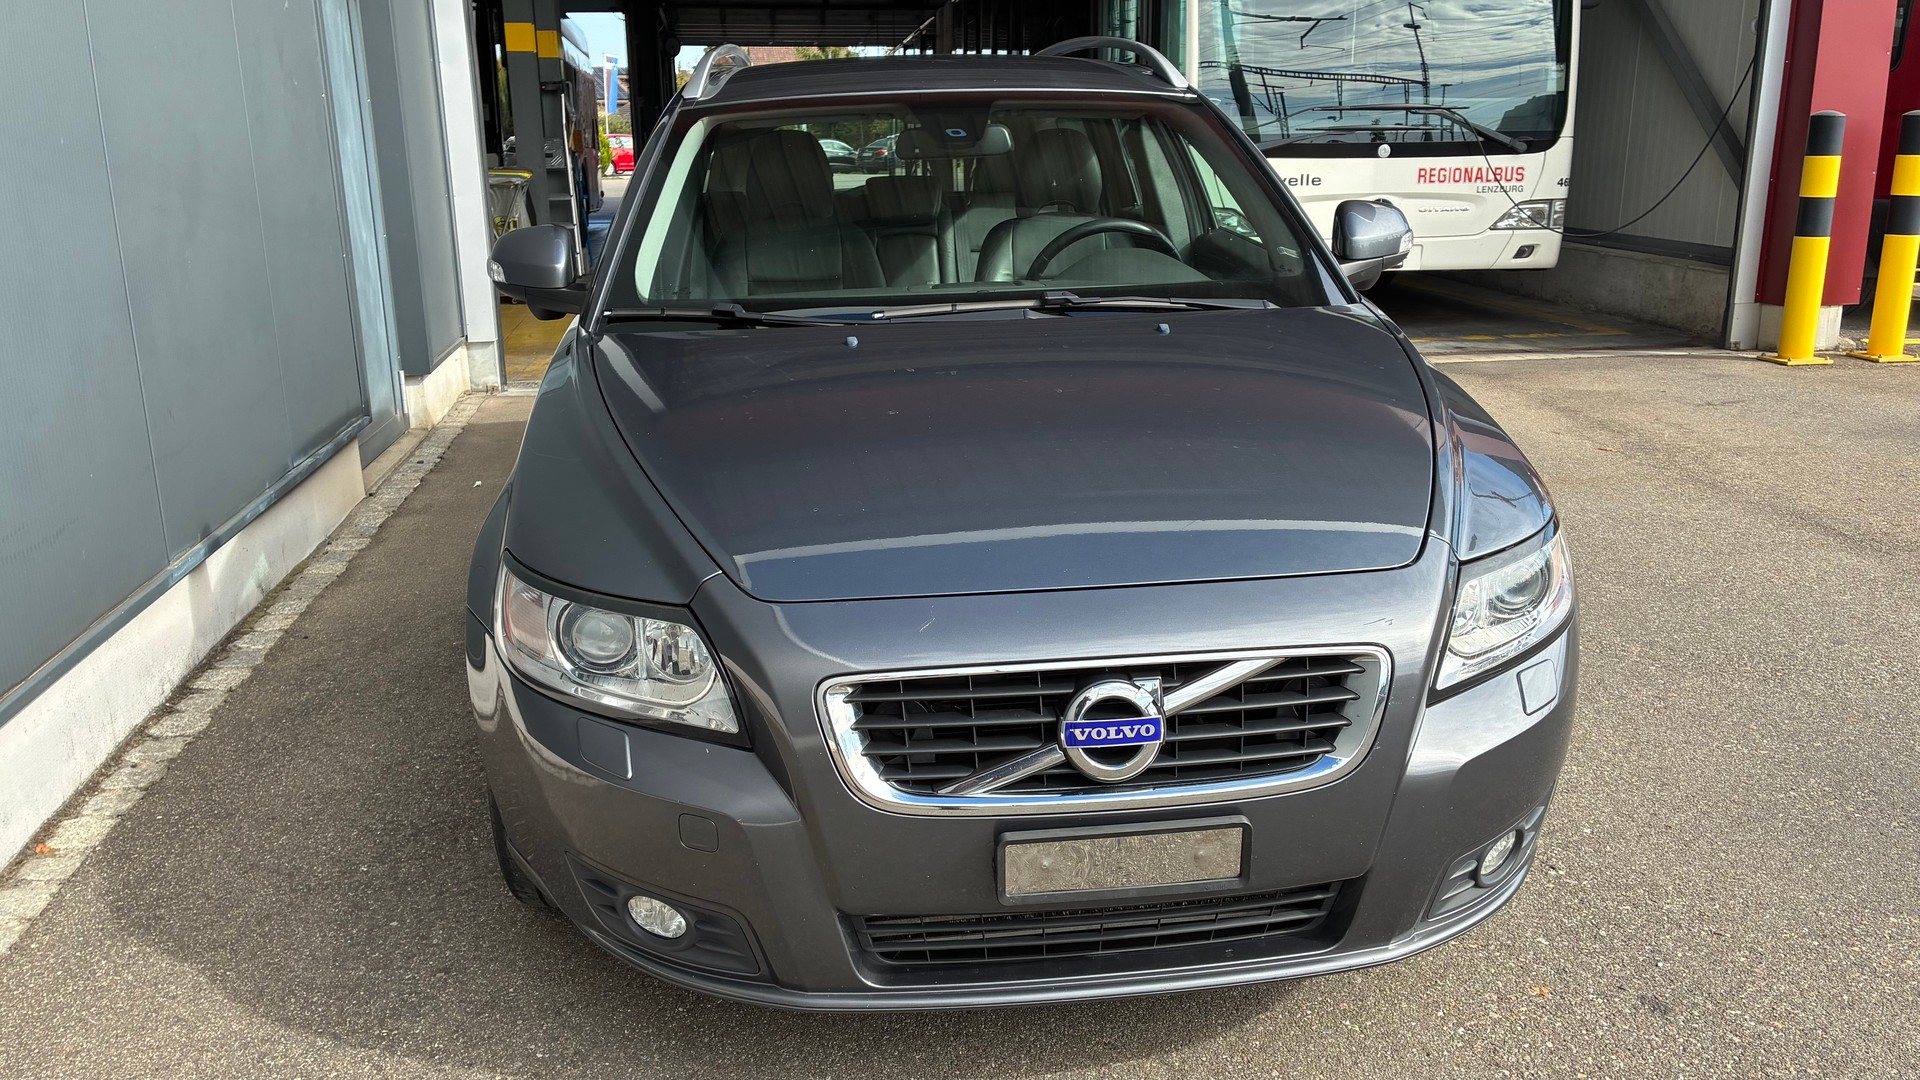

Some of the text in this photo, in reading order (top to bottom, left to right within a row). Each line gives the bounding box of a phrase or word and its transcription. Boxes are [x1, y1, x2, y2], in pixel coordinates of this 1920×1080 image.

[1417, 166, 1526, 184] REGIONALBUS
[1476, 185, 1524, 194] LENZBURG
[1069, 723, 1156, 741] VOLVO
